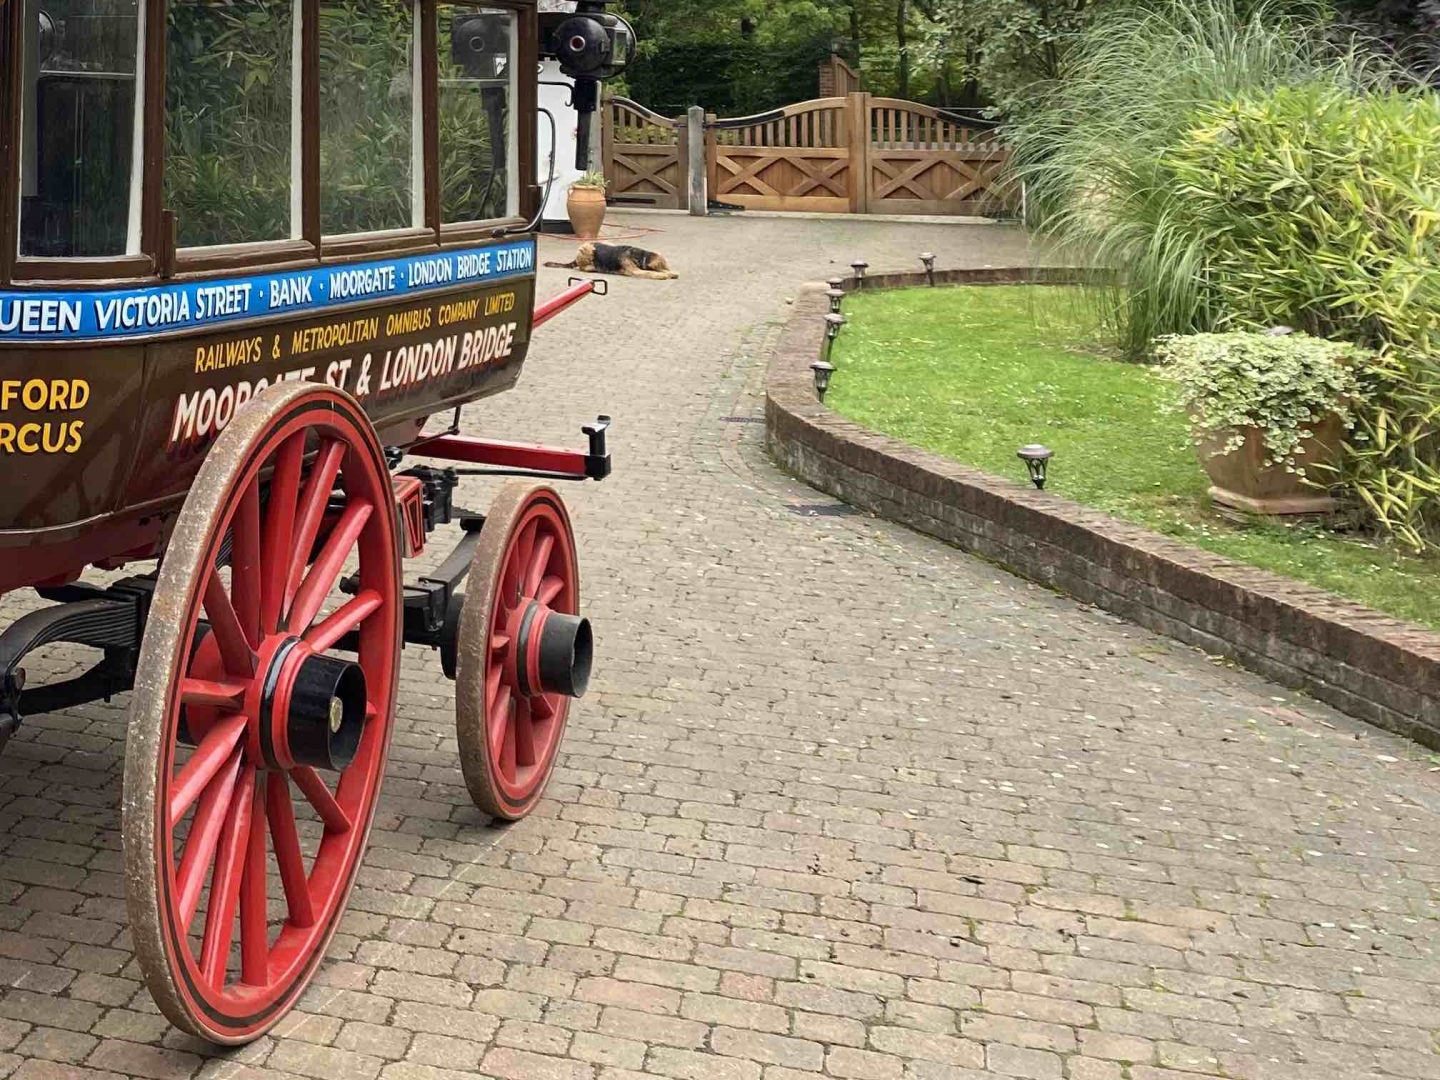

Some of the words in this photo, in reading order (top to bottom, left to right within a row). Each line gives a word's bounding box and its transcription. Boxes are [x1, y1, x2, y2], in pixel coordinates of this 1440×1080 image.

[95, 291, 190, 330] VICTORIA
[195, 283, 252, 314] STREET
[270, 276, 313, 308] BANK
[328, 265, 396, 299] MOORGATE
[408, 259, 452, 287] LONDON
[457, 252, 491, 279] BRIDGE
[497, 247, 532, 271] STATION
[195, 337, 262, 373] RAILWAYS
[272, 341, 281, 360] &
[292, 318, 378, 355] METROPOLITAN
[386, 307, 431, 336] OMNIBUS
[439, 298, 480, 325] COMPANY
[484, 292, 515, 317] LIMITED
[356, 353, 371, 396] &
[380, 337, 455, 391] LONDON
[458, 322, 516, 370] BRIDGE
